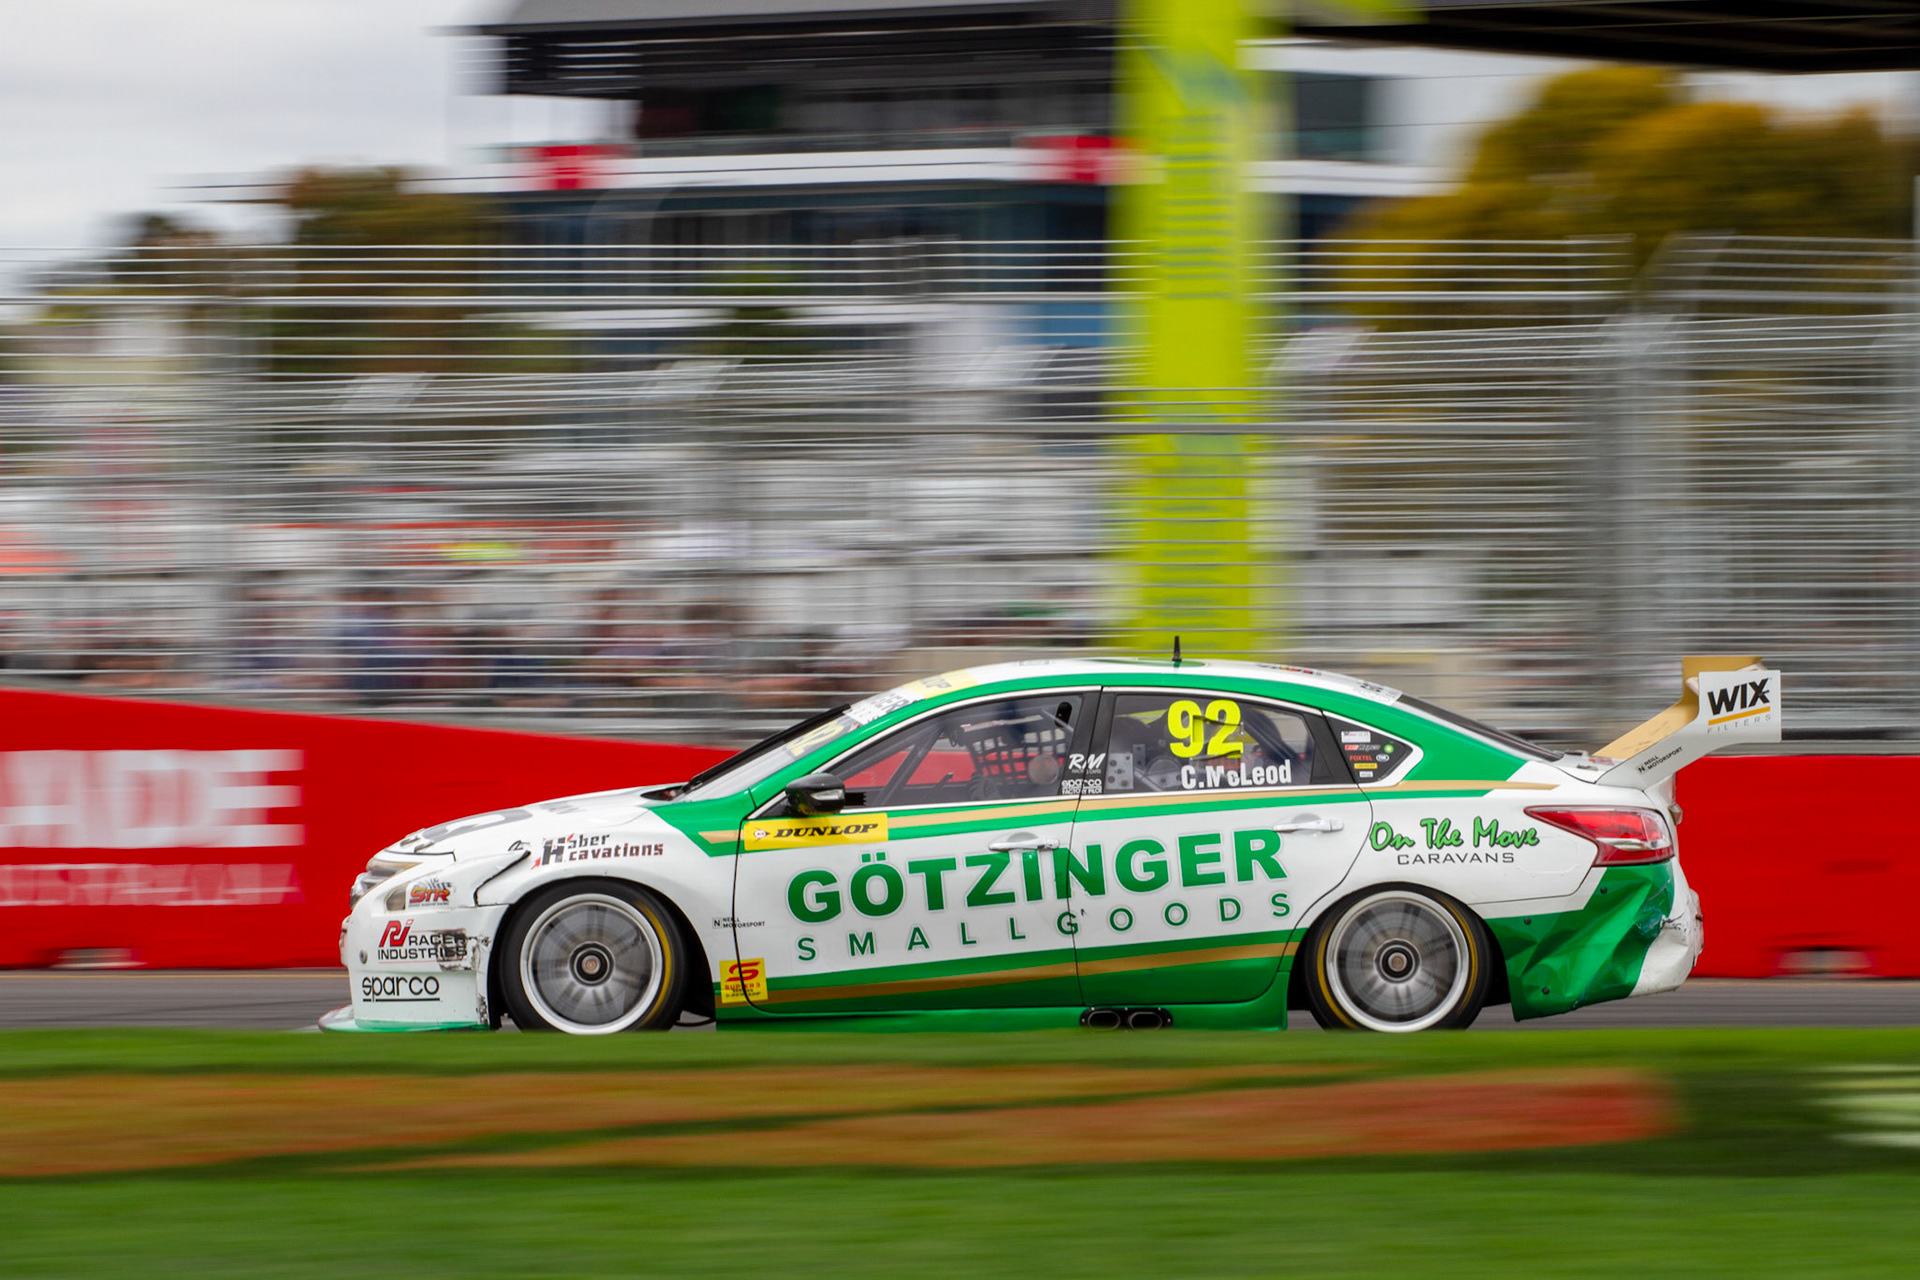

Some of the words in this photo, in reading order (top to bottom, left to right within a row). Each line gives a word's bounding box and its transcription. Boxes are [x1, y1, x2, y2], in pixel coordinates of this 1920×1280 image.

[1707, 677, 1770, 716] WIX
[1167, 699, 1243, 758] 92
[1707, 714, 1771, 734] FILTERS
[1647, 746, 1683, 770] MOTORSPORT
[774, 823, 878, 838] DUNLOP
[1370, 821, 1415, 851] On
[1420, 818, 1463, 849] The
[1473, 816, 1540, 849] Move
[1397, 852, 1514, 865] CARAVANS
[787, 829, 1288, 923] GÖTZINGER
[409, 887, 451, 904] STR
[797, 893, 1290, 961] SMALLGOODS
[362, 975, 440, 1002] sparco
